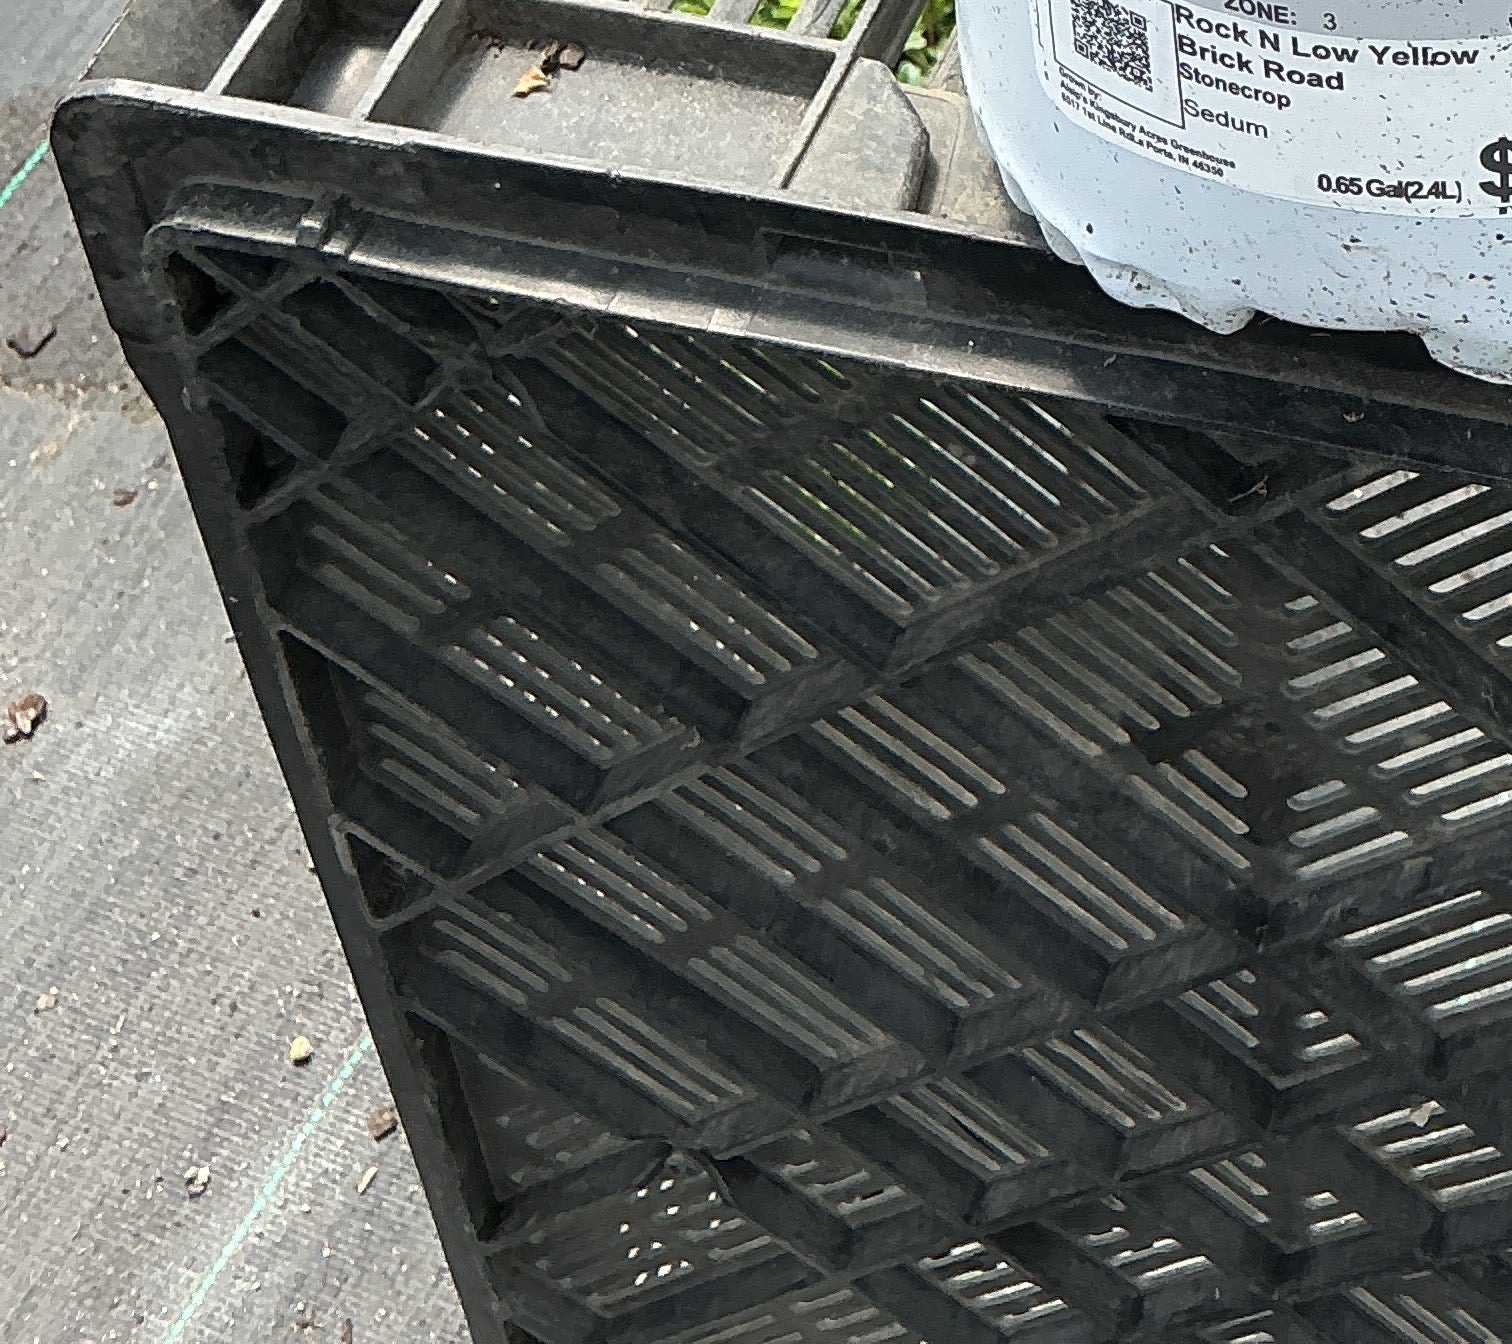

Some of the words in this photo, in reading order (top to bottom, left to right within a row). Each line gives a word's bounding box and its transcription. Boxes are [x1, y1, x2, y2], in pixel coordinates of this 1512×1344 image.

[1174, 3, 1253, 47] Rock
[1259, 29, 1280, 52] N
[1292, 36, 1359, 64] Low
[1369, 44, 1480, 67] Yellow
[1323, 12, 1337, 31] 3
[1059, 66, 1086, 91] Grown
[1177, 34, 1254, 75] Brick
[1263, 59, 1344, 91] Road
[1179, 62, 1291, 111] Stonecrop
[1090, 99, 1136, 132] Kingsbury
[1139, 126, 1168, 145] Acres
[1170, 139, 1236, 169] Greenhouse
[1184, 97, 1269, 139] Sedum
[1318, 174, 1363, 195] 0.65
